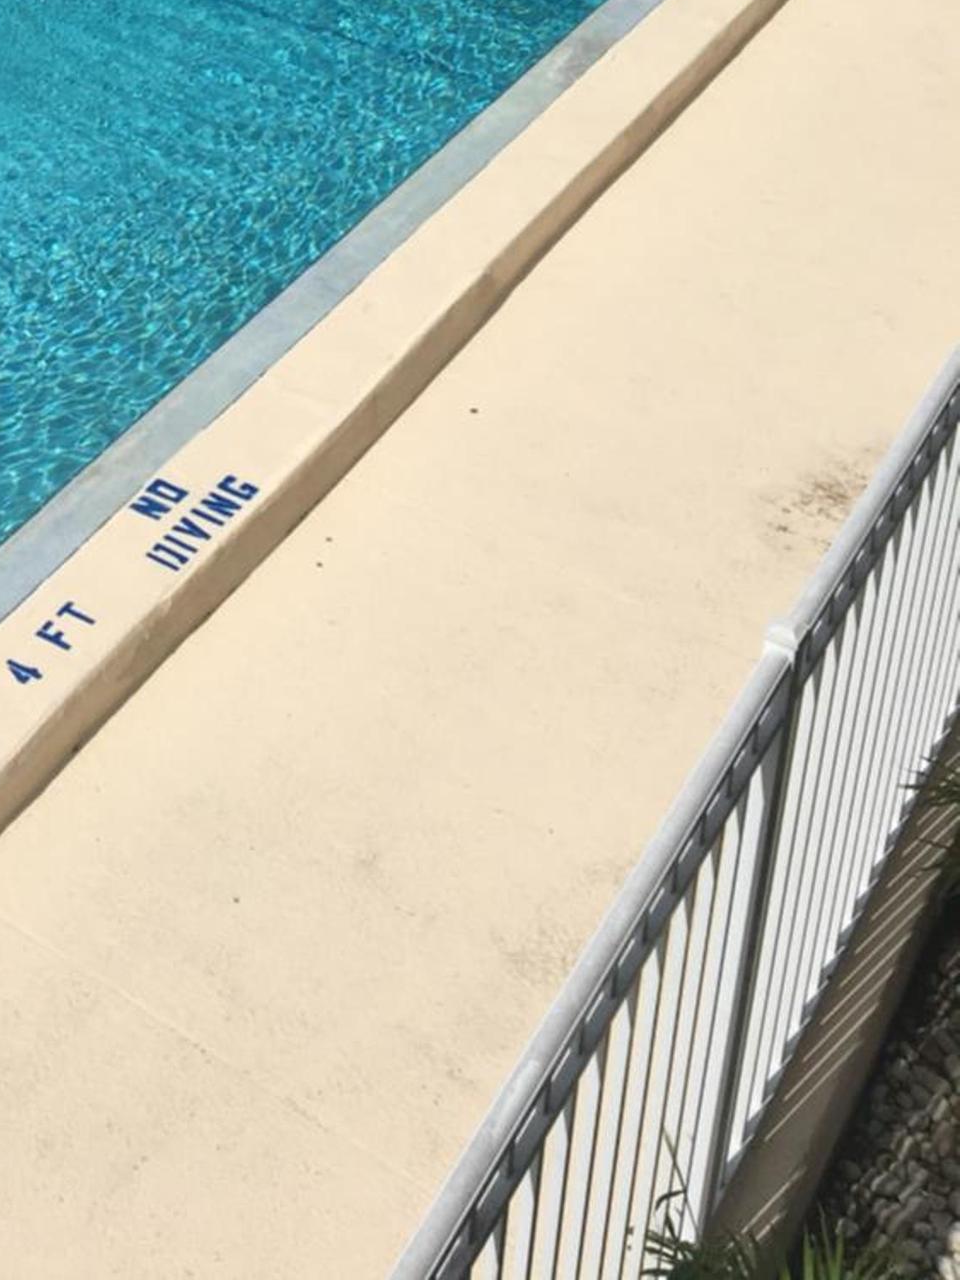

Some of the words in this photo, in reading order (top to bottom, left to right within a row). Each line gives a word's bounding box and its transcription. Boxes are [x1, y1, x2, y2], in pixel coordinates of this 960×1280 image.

[129, 477, 190, 522] NO
[145, 474, 261, 572] DIVING
[5, 658, 43, 685] 4
[35, 600, 97, 651] FT
